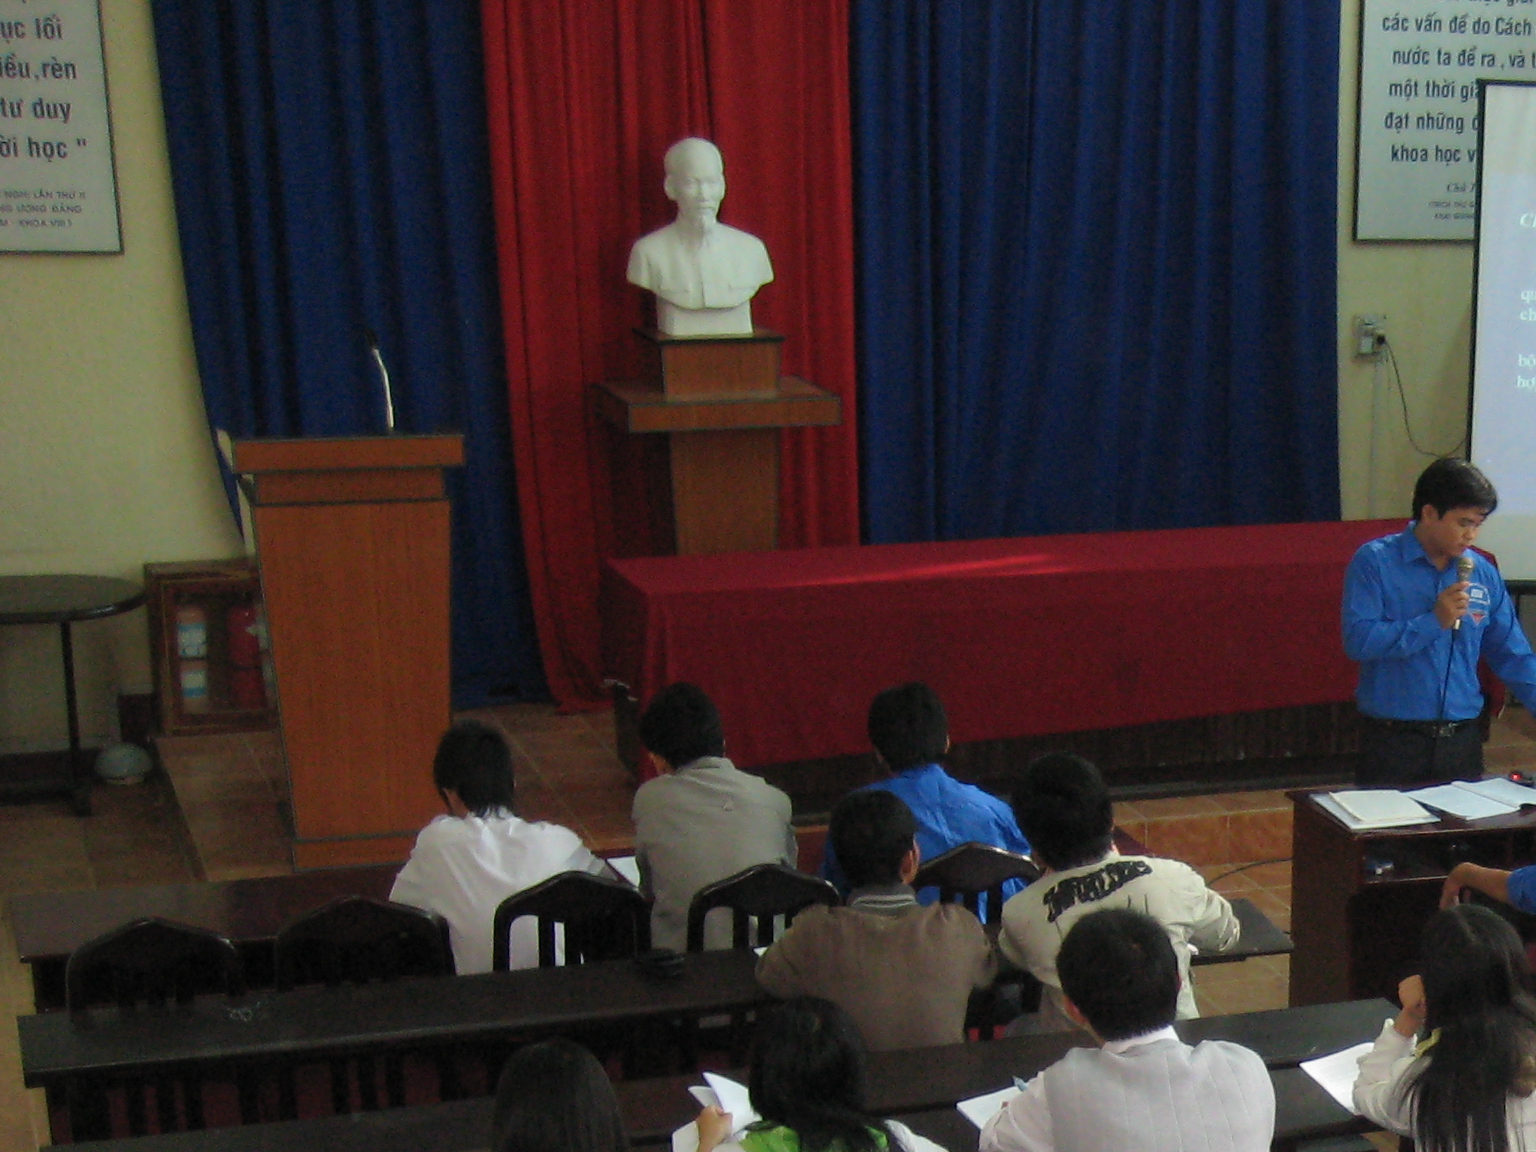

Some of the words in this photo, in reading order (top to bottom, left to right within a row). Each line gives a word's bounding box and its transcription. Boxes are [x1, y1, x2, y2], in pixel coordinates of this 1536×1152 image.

[1382, 12, 1409, 32] các
[1473, 16, 1490, 35] do
[1495, 16, 1531, 36] Cách
[1392, 46, 1430, 65] nước
[1437, 48, 1451, 66] ta
[1508, 49, 1525, 68] và
[1389, 78, 1419, 101] một
[1425, 78, 1455, 98] thời
[32, 96, 71, 125] duy
[1384, 112, 1409, 134] đạt
[1416, 112, 1464, 134] những
[1391, 144, 1428, 162] khoa
[1435, 144, 1461, 166] học
